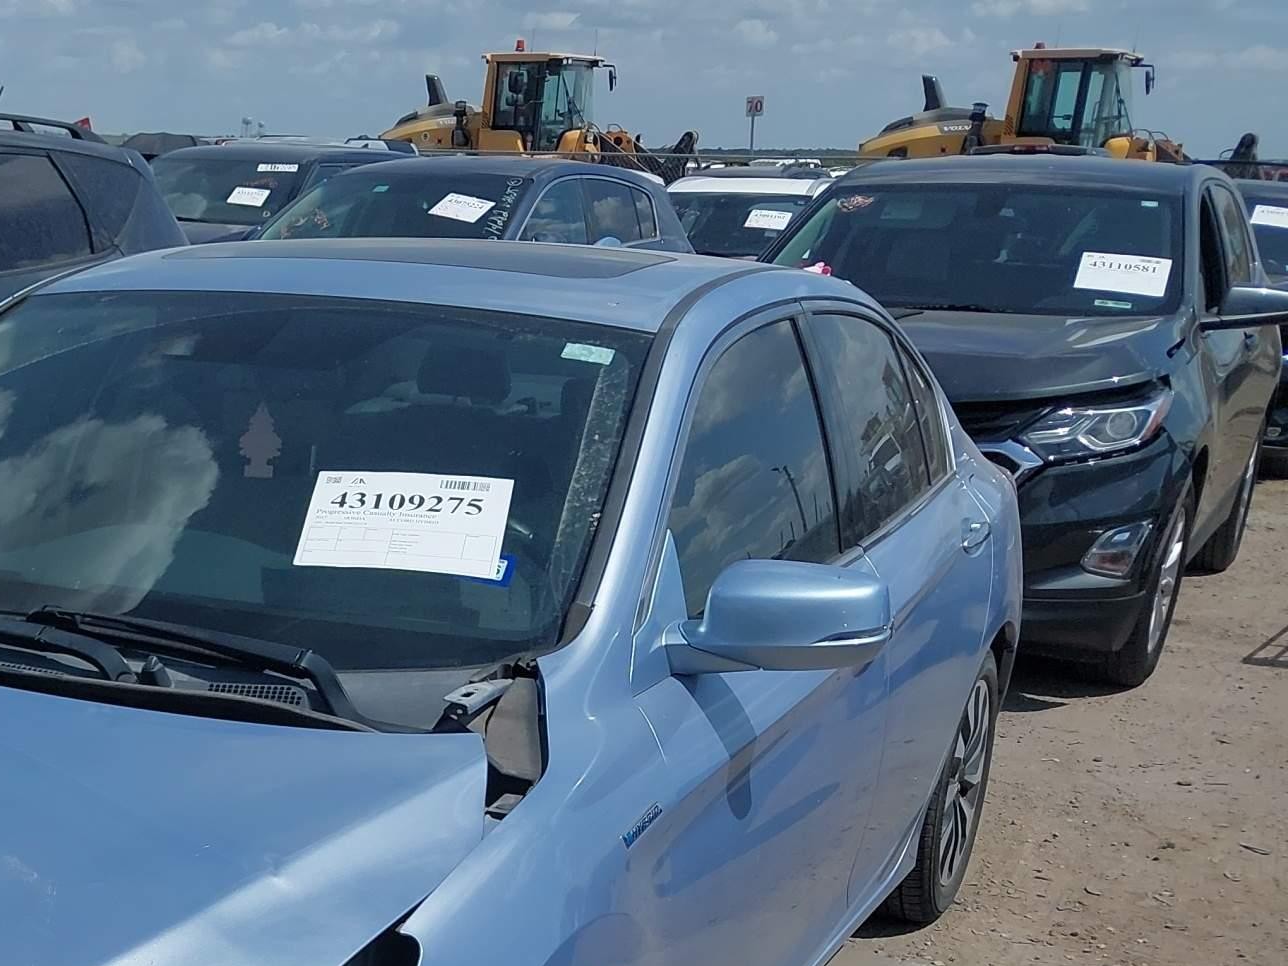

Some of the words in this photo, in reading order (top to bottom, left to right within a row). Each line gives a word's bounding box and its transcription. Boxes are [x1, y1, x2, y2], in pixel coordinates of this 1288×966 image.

[746, 100, 763, 113] 70
[1089, 260, 1158, 274] 43110581
[330, 491, 484, 515] 43109275
